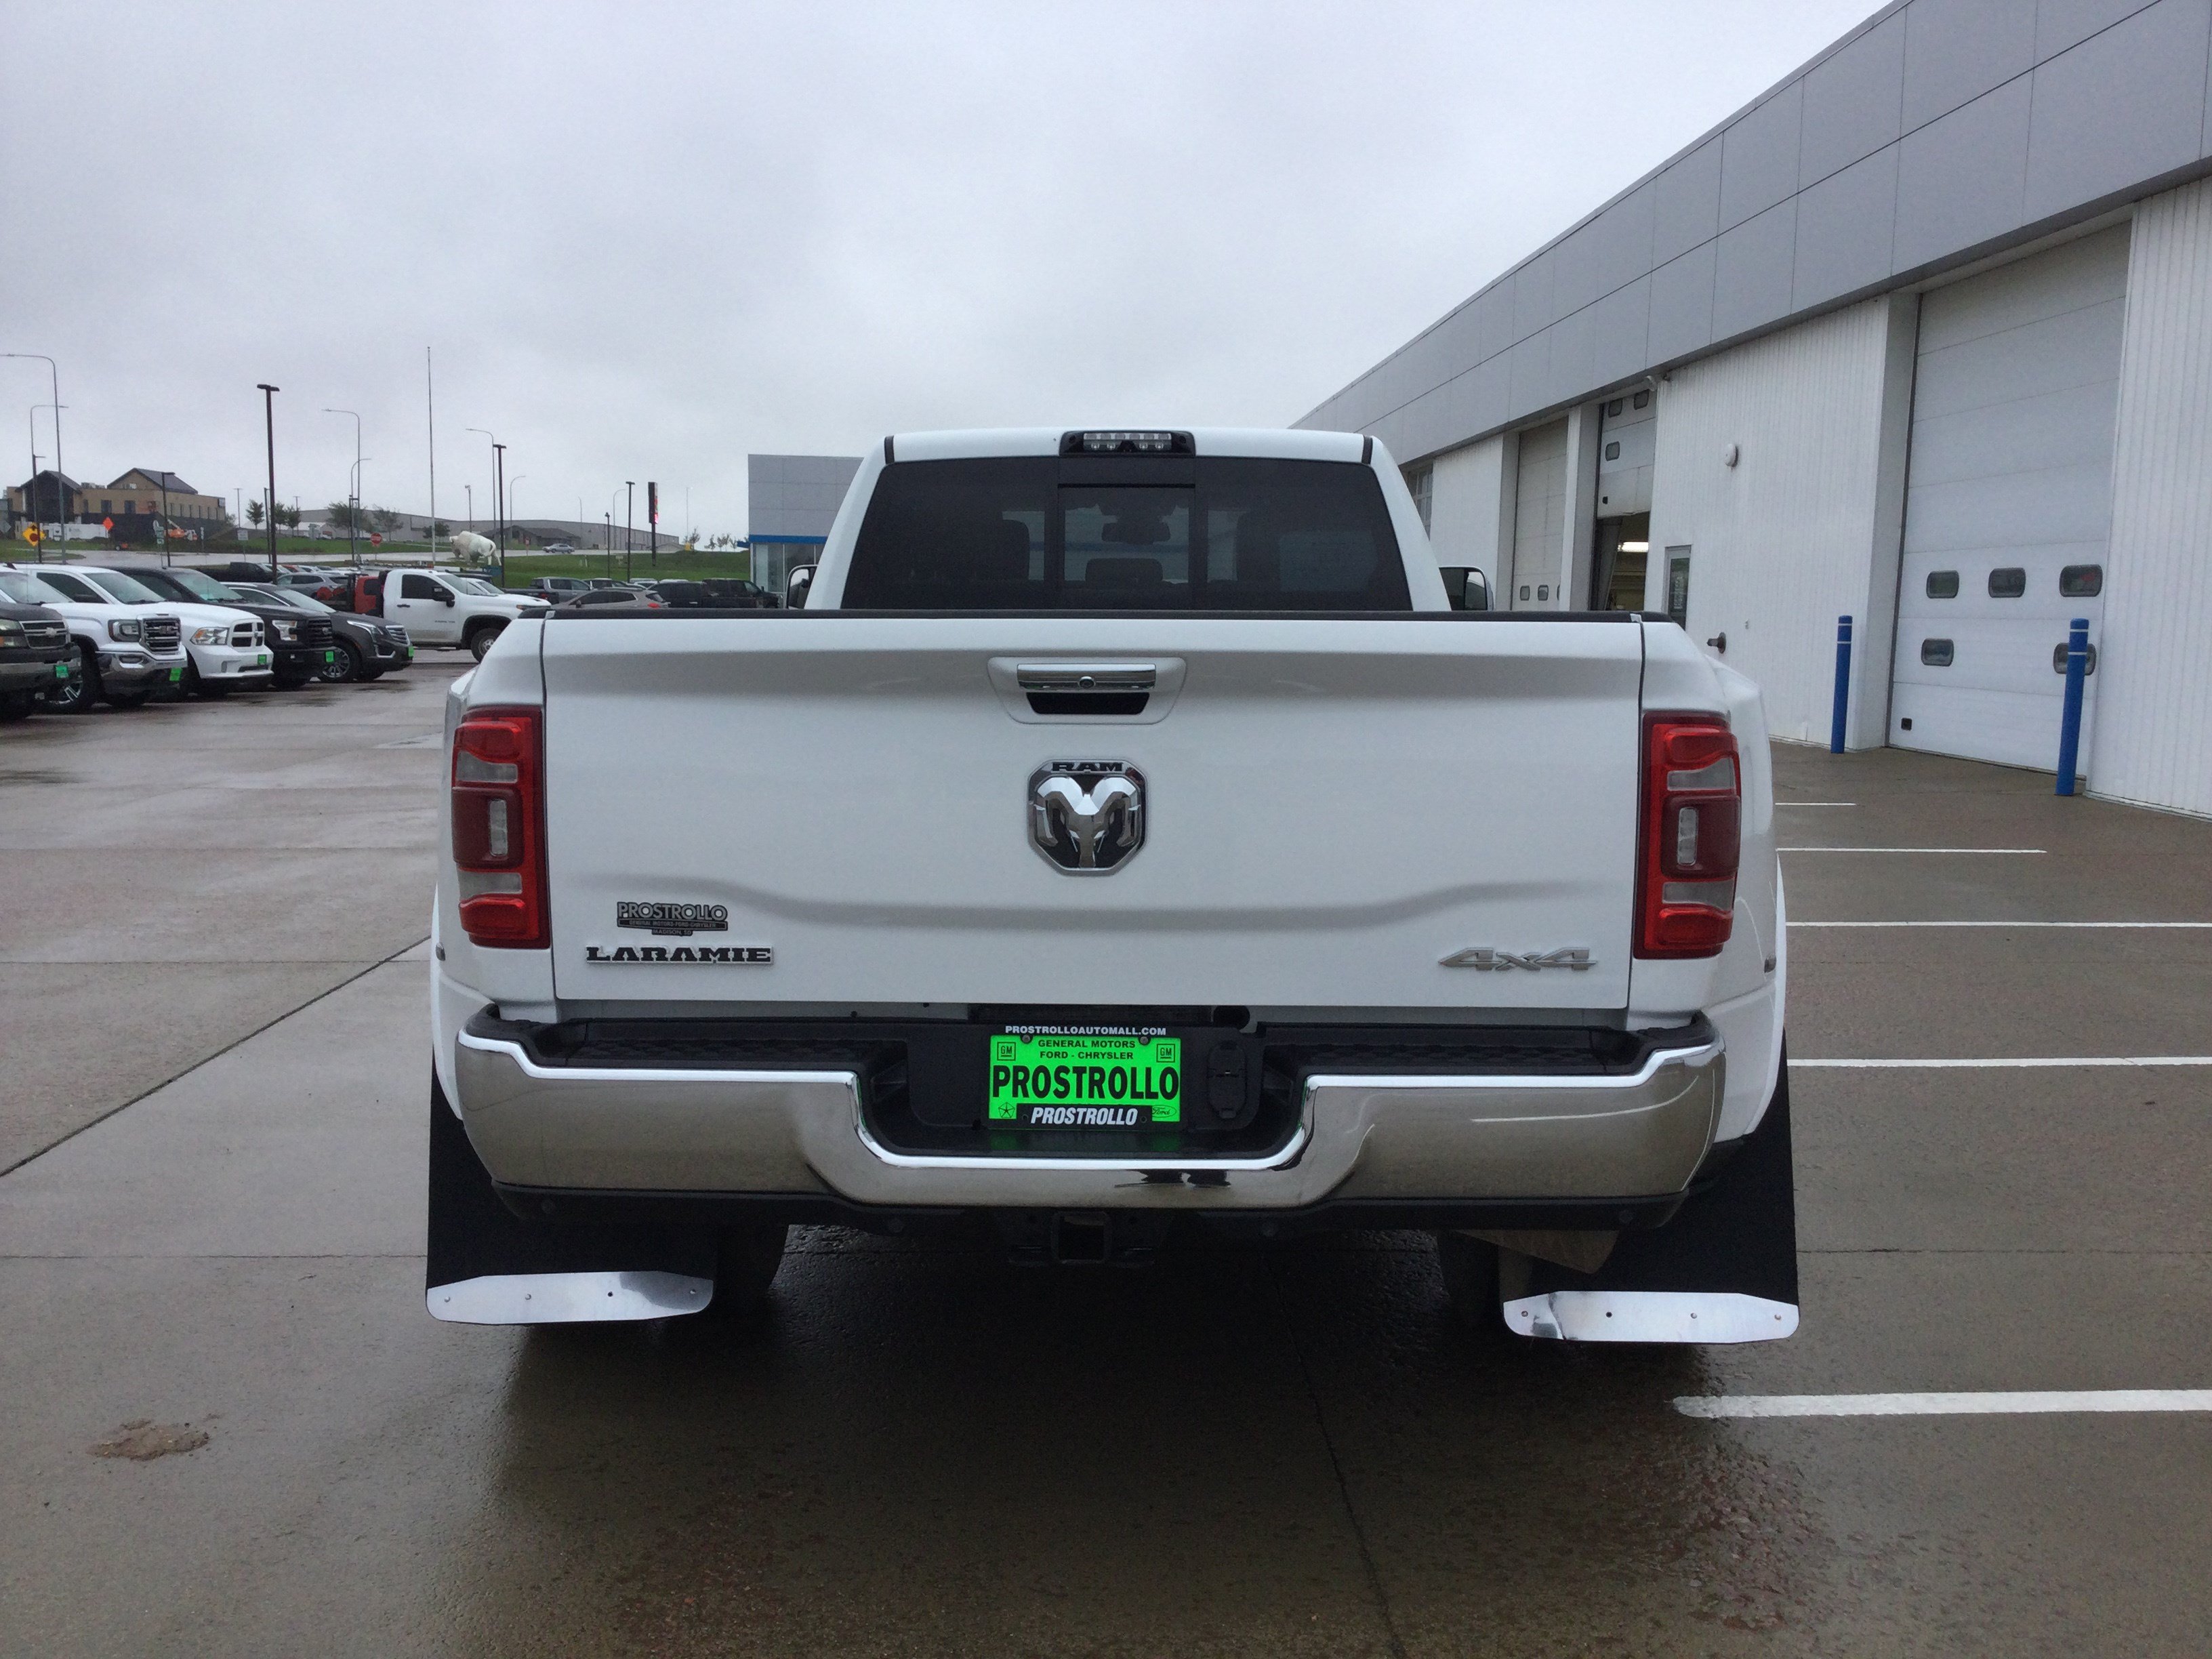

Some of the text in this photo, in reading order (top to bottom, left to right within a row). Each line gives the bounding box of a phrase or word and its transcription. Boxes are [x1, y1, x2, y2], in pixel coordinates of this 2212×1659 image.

[1052, 762, 1123, 772] RAM
[617, 902, 727, 922] PROSTROLLO
[586, 946, 771, 962] LARAMIE
[1005, 1025, 1166, 1036] PROSTROLLOAUTOMALL.COM
[1038, 1040, 1136, 1048] GENERAL MOTORS
[1000, 1045, 1012, 1054] GM
[1160, 1047, 1172, 1057] GM
[1039, 1051, 1069, 1059] FORD
[1078, 1051, 1134, 1060] CHRYSLER
[992, 1065, 1179, 1100] PROSTROLLO
[1152, 1107, 1170, 1115] Ford
[1030, 1107, 1139, 1126] PROSTROLLO
